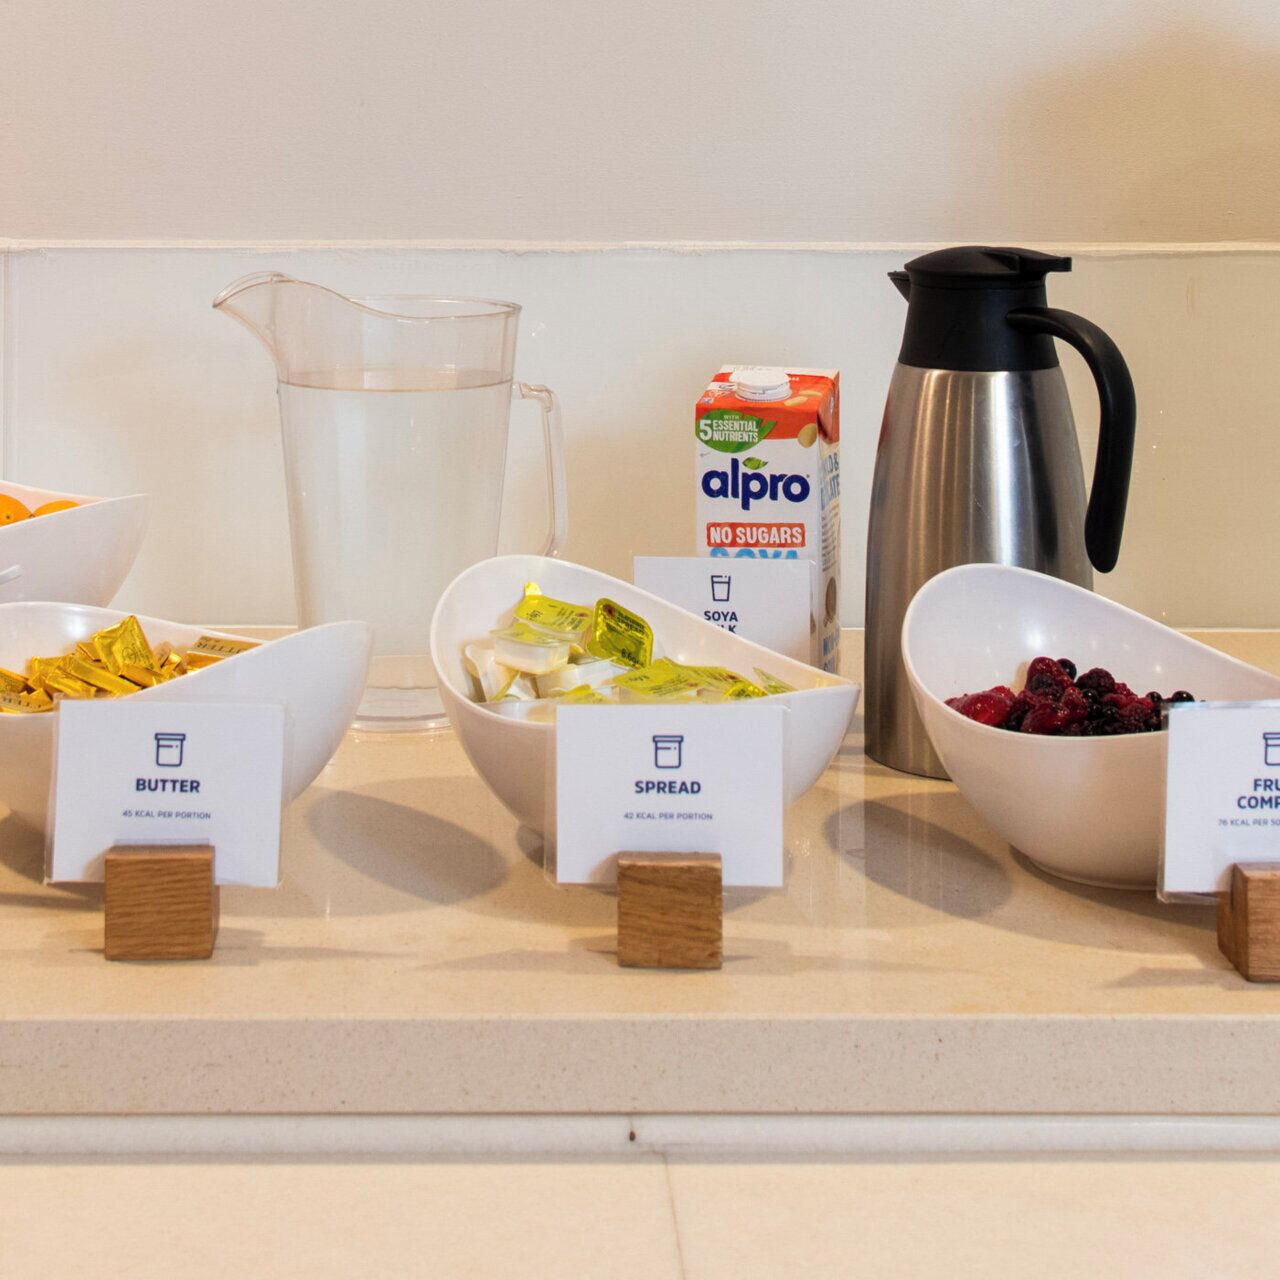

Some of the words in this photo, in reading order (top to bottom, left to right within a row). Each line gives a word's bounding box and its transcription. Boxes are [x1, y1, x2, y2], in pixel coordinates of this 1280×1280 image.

[699, 419, 712, 441] 5
[713, 420, 758, 431] ESSENTIAL
[713, 431, 758, 442] NUTRIENTS
[701, 458, 810, 510] alpro
[709, 526, 732, 544] NO
[735, 526, 802, 545] SUGARS
[704, 611, 738, 622] SOYA
[136, 778, 200, 794] BUTTER
[634, 780, 702, 795] SPREAD
[122, 810, 133, 818] 45
[134, 810, 155, 819] KCAL
[158, 810, 173, 819] PER
[175, 811, 212, 820] PORTION
[623, 812, 634, 820] 42
[636, 812, 657, 820] KCAL
[659, 812, 674, 820] PER
[676, 812, 713, 821] PORTION
